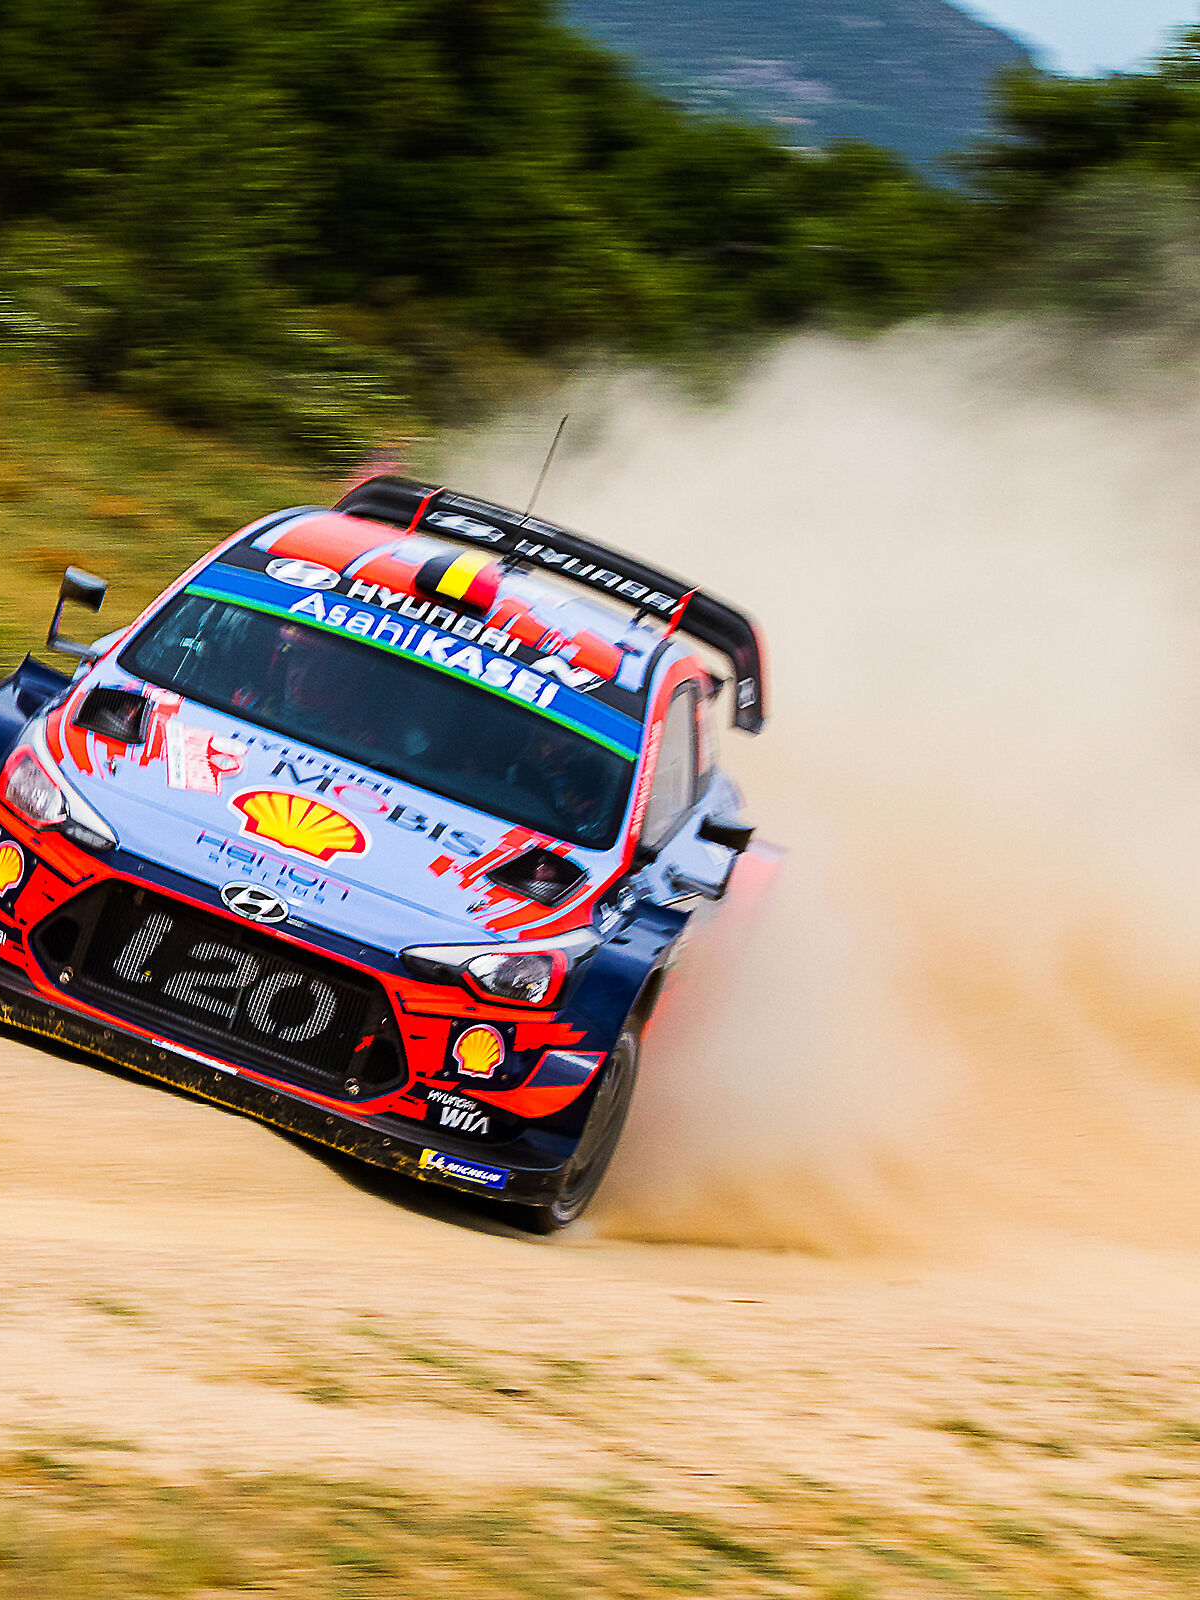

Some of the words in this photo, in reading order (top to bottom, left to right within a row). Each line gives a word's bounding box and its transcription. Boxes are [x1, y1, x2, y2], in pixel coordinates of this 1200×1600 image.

[514, 539, 684, 615] HYUNDAI
[288, 591, 561, 709] AsahiKASEI
[346, 579, 522, 657] HYUNDAI
[270, 759, 486, 857] MOBIS
[427, 1089, 477, 1111] HYUNDAI
[439, 1106, 490, 1134] WIA
[446, 1162, 502, 1182] MICHELIN
